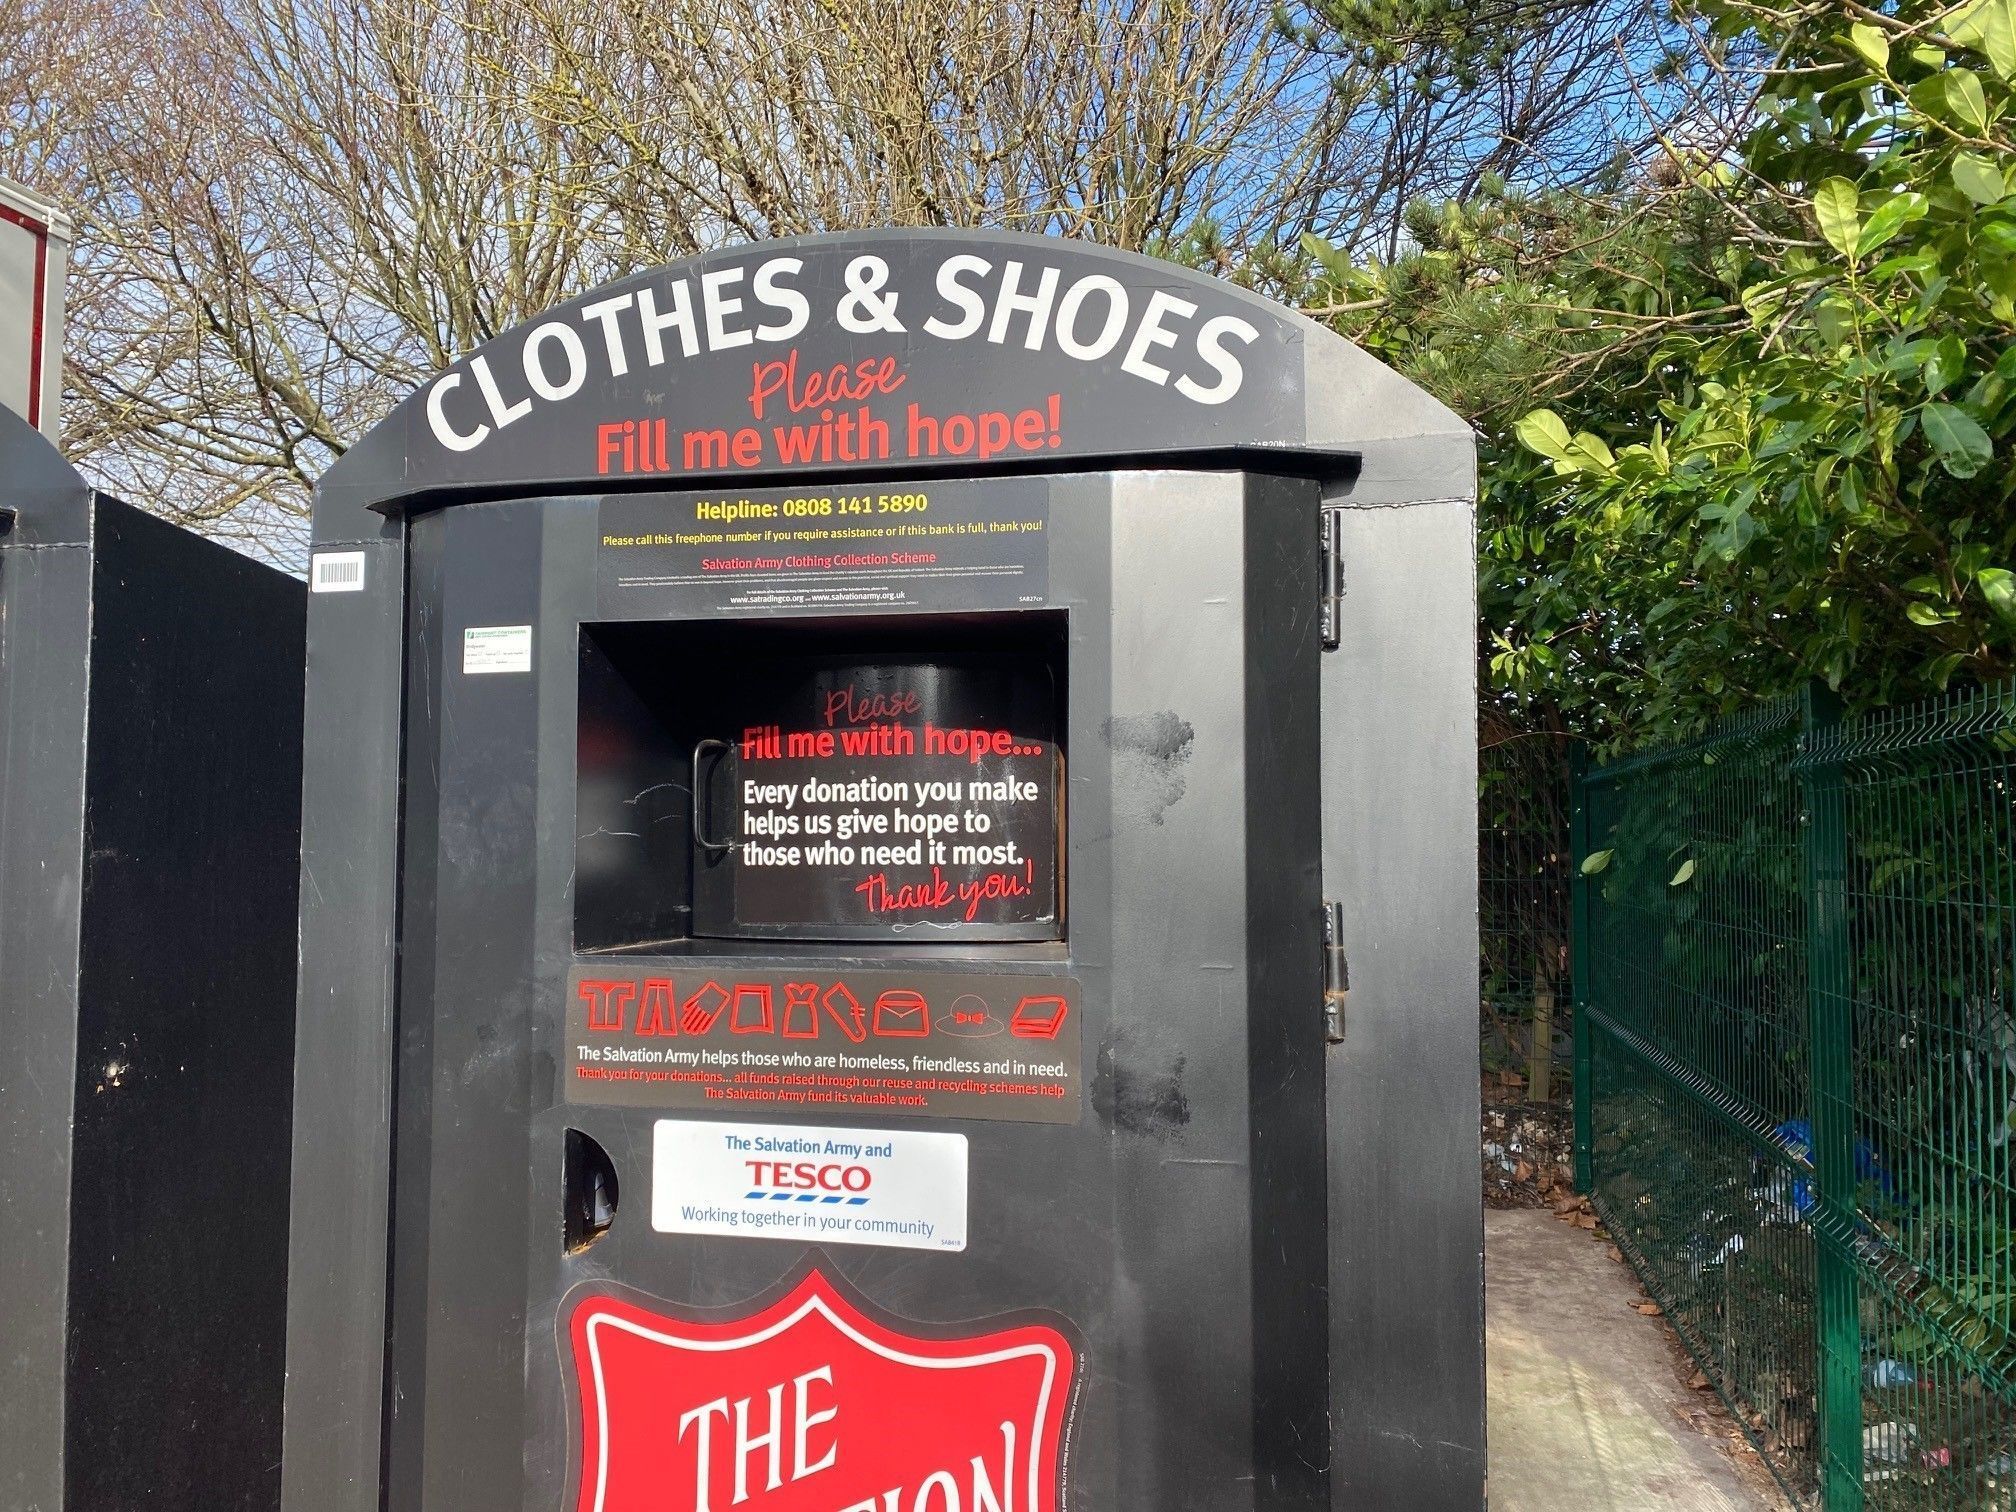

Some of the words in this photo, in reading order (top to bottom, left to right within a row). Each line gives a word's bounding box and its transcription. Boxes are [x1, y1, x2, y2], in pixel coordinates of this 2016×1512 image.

[426, 257, 810, 452] CLOTHES
[836, 255, 908, 334] &
[922, 254, 1260, 405] SHOES
[748, 349, 906, 420] Please
[598, 418, 670, 474] Fill
[683, 428, 762, 470] me
[773, 407, 889, 464] with
[907, 393, 1061, 459] hope!
[696, 501, 778, 523] Helpline:
[783, 498, 832, 517] 0808
[838, 496, 872, 515] 141
[878, 494, 928, 513] 5890
[603, 536, 634, 546] Please
[636, 534, 652, 545] call
[655, 533, 673, 544] this
[675, 533, 723, 547] freephone
[726, 531, 761, 542] number
[764, 530, 772, 541] if
[773, 531, 791, 543] you
[793, 530, 828, 542] require
[830, 528, 883, 539] assistance
[885, 528, 897, 537] or
[899, 525, 907, 536] if
[908, 525, 926, 536] this
[929, 524, 954, 535] bank
[957, 523, 965, 534] is
[968, 522, 987, 535] full,
[989, 521, 1018, 532] thank
[1020, 520, 1042, 533] you!
[702, 558, 752, 570] Salvation
[754, 557, 783, 571] Army
[785, 555, 831, 569] Clothing
[833, 553, 888, 566] Collection
[891, 552, 936, 564] Scheme
[730, 595, 804, 604] www.satradingco.org
[812, 591, 906, 602] www.salvationarmy.org.uk
[823, 684, 920, 726] Please
[741, 726, 781, 760] Fill
[789, 731, 835, 757] me
[840, 722, 914, 756] with
[924, 721, 1043, 763] hope...
[744, 780, 798, 809] Every
[802, 776, 908, 803] donation
[914, 782, 962, 807] you
[968, 775, 1038, 801] make
[744, 810, 799, 840] helps
[805, 816, 831, 834] us
[836, 809, 888, 839] give
[894, 808, 958, 839] hope
[964, 810, 991, 833] to
[743, 841, 801, 866] those
[805, 841, 854, 865] who
[860, 840, 922, 865] need
[928, 841, 946, 865] it
[953, 842, 1024, 865] most.
[855, 867, 955, 913] Thank
[955, 858, 1034, 921] you!
[577, 1046, 600, 1061] The
[603, 1046, 662, 1063] Salvation
[665, 1048, 700, 1067] Army
[702, 1049, 738, 1067] helps
[741, 1051, 779, 1066] those
[782, 1051, 811, 1067] who
[814, 1055, 836, 1068] are
[839, 1053, 910, 1072] homeless,
[912, 1055, 980, 1074] friendless
[983, 1059, 1010, 1075] and
[1013, 1060, 1025, 1076] in
[1029, 1061, 1068, 1078] need.
[576, 1066, 607, 1079] Thank
[608, 1069, 627, 1081] you
[629, 1068, 644, 1080] for
[645, 1070, 669, 1082] your
[670, 1070, 732, 1083] donations...
[734, 1071, 747, 1083] all
[750, 1072, 779, 1084] funds
[782, 1073, 814, 1085] raised
[817, 1074, 860, 1088] through
[862, 1078, 880, 1087] our
[883, 1079, 913, 1089] reuse
[915, 1078, 936, 1090] and
[938, 1079, 987, 1094] recycling
[989, 1082, 1037, 1095] schemes
[1040, 1084, 1064, 1098] help
[705, 1087, 724, 1099] The
[726, 1087, 775, 1100] Salvation
[777, 1089, 806, 1103] Army
[808, 1090, 832, 1102] fund
[834, 1092, 848, 1103] its
[850, 1092, 896, 1104] valuable
[898, 1095, 928, 1106] work.
[725, 1135, 751, 1151] The
[754, 1136, 820, 1154] Salvation
[824, 1140, 861, 1159] Army
[865, 1143, 892, 1158] and
[745, 1160, 872, 1192] TESCO
[681, 1206, 738, 1227] Working
[742, 1208, 800, 1230] together
[803, 1211, 816, 1227] in
[820, 1215, 851, 1231] your
[854, 1217, 935, 1238] community
[677, 1365, 839, 1512] THE
